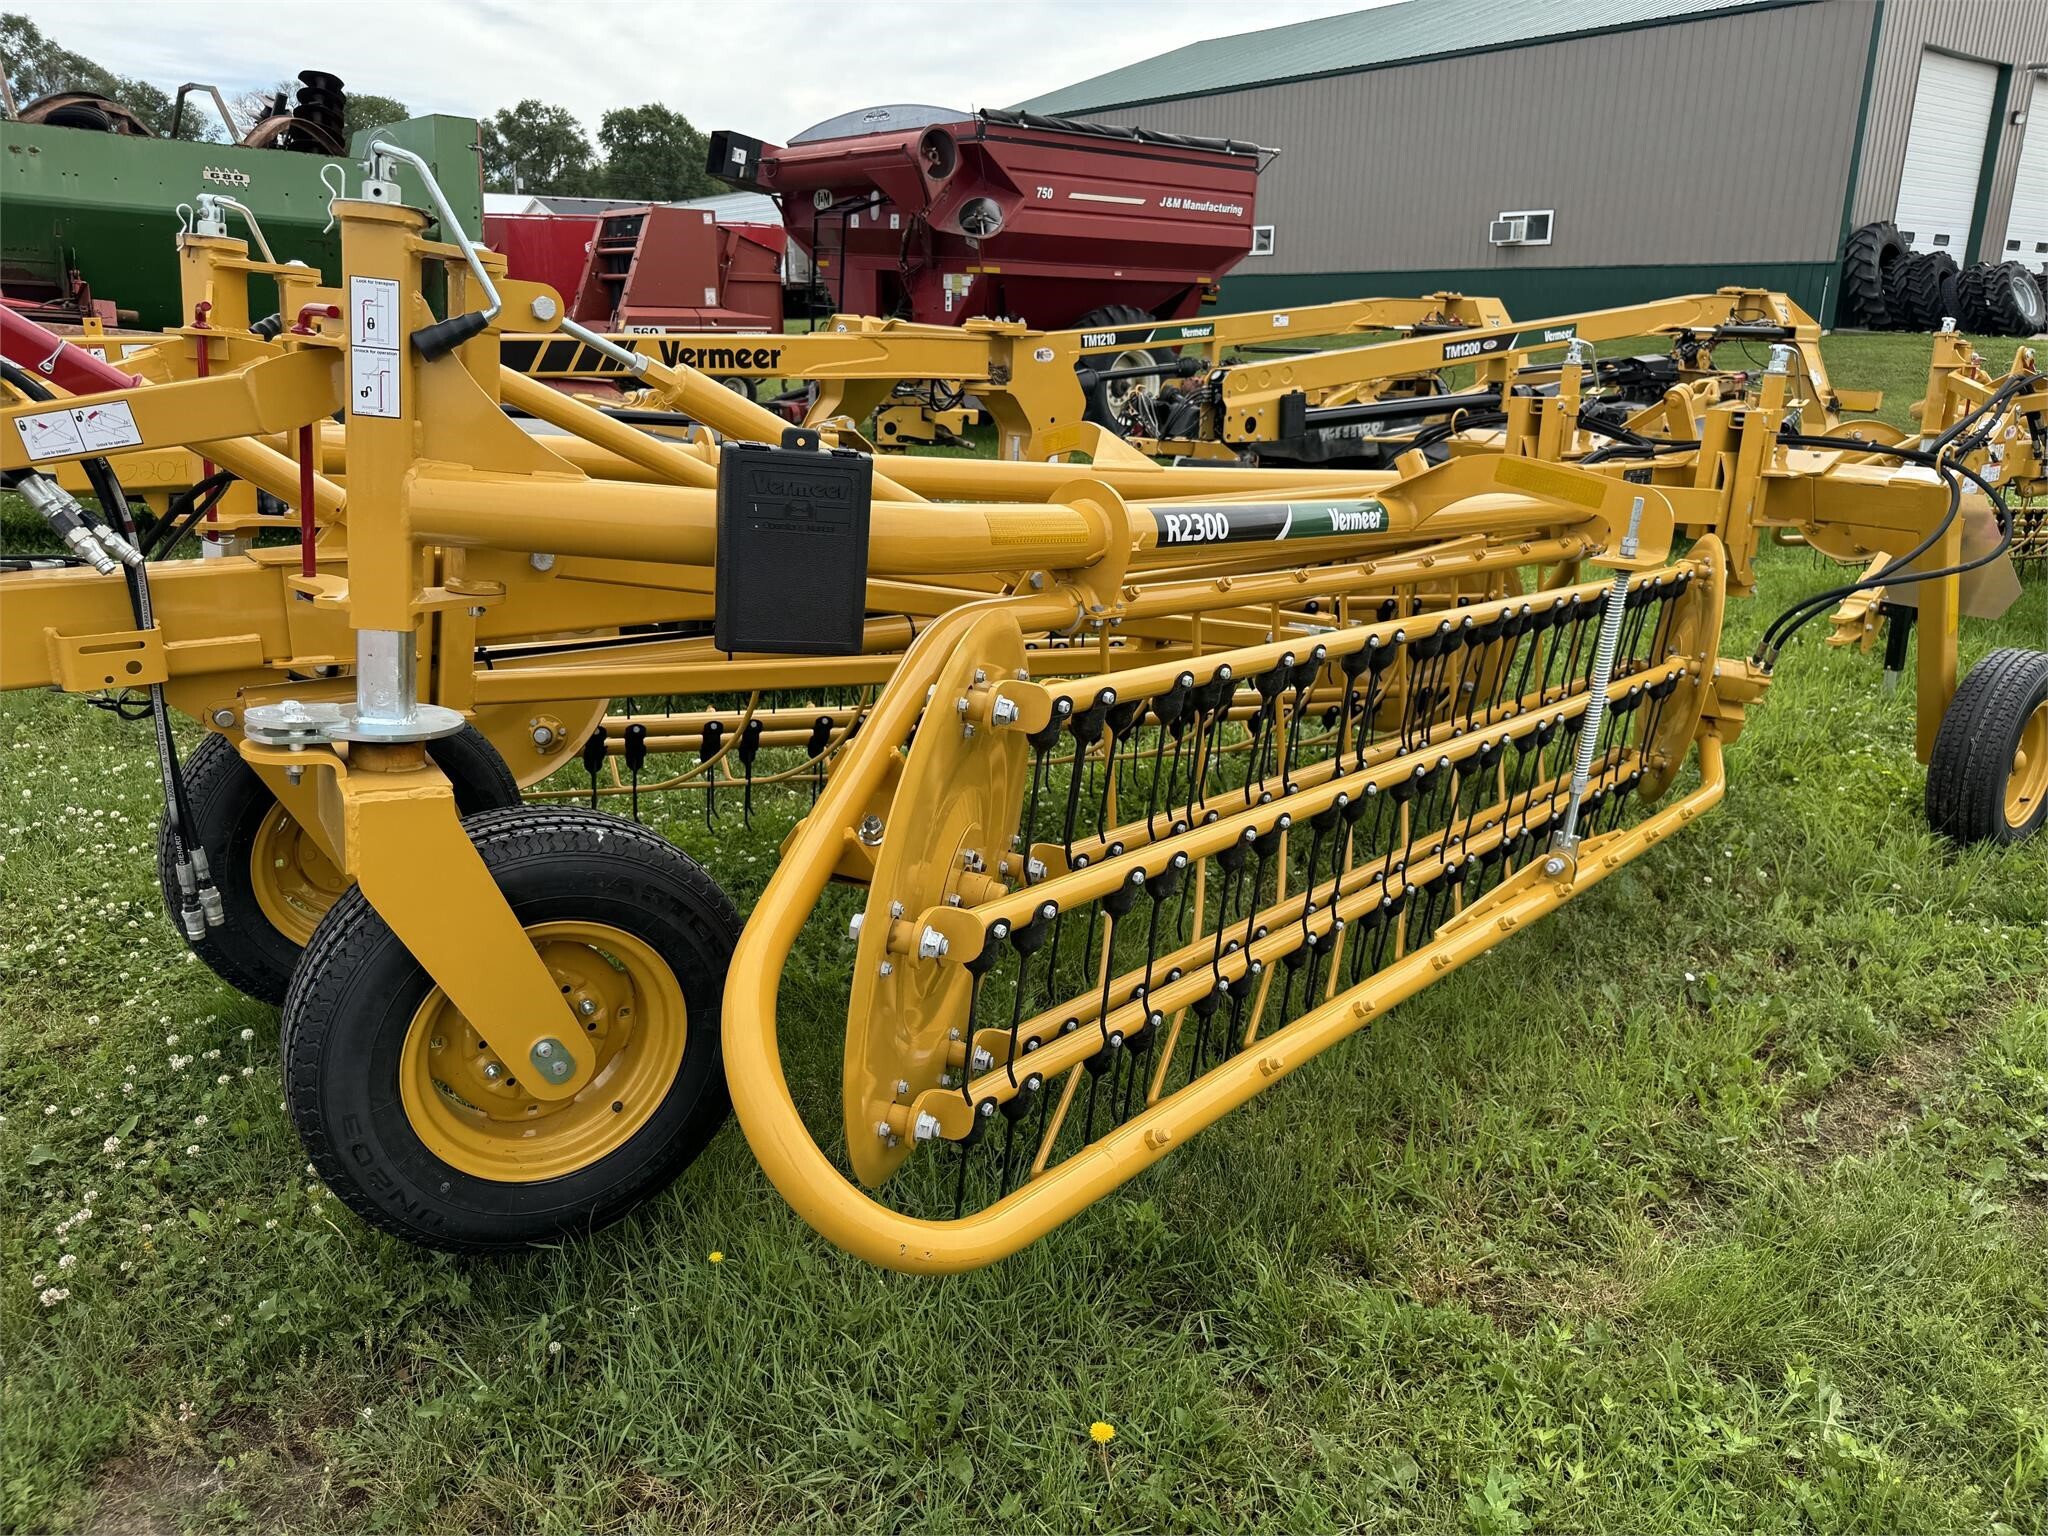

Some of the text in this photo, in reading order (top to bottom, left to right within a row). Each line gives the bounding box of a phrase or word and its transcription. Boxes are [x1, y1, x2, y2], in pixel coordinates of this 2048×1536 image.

[1036, 186, 1054, 200] 750
[1159, 196, 1243, 217] J&M Manufacturing
[1083, 327, 1214, 347] TM1210 Vermeer
[1445, 342, 1481, 359] TM1200
[1544, 328, 1574, 342] Vermeer
[659, 340, 781, 369] Vermeer
[1164, 507, 1384, 543] R2300 Vermeer
